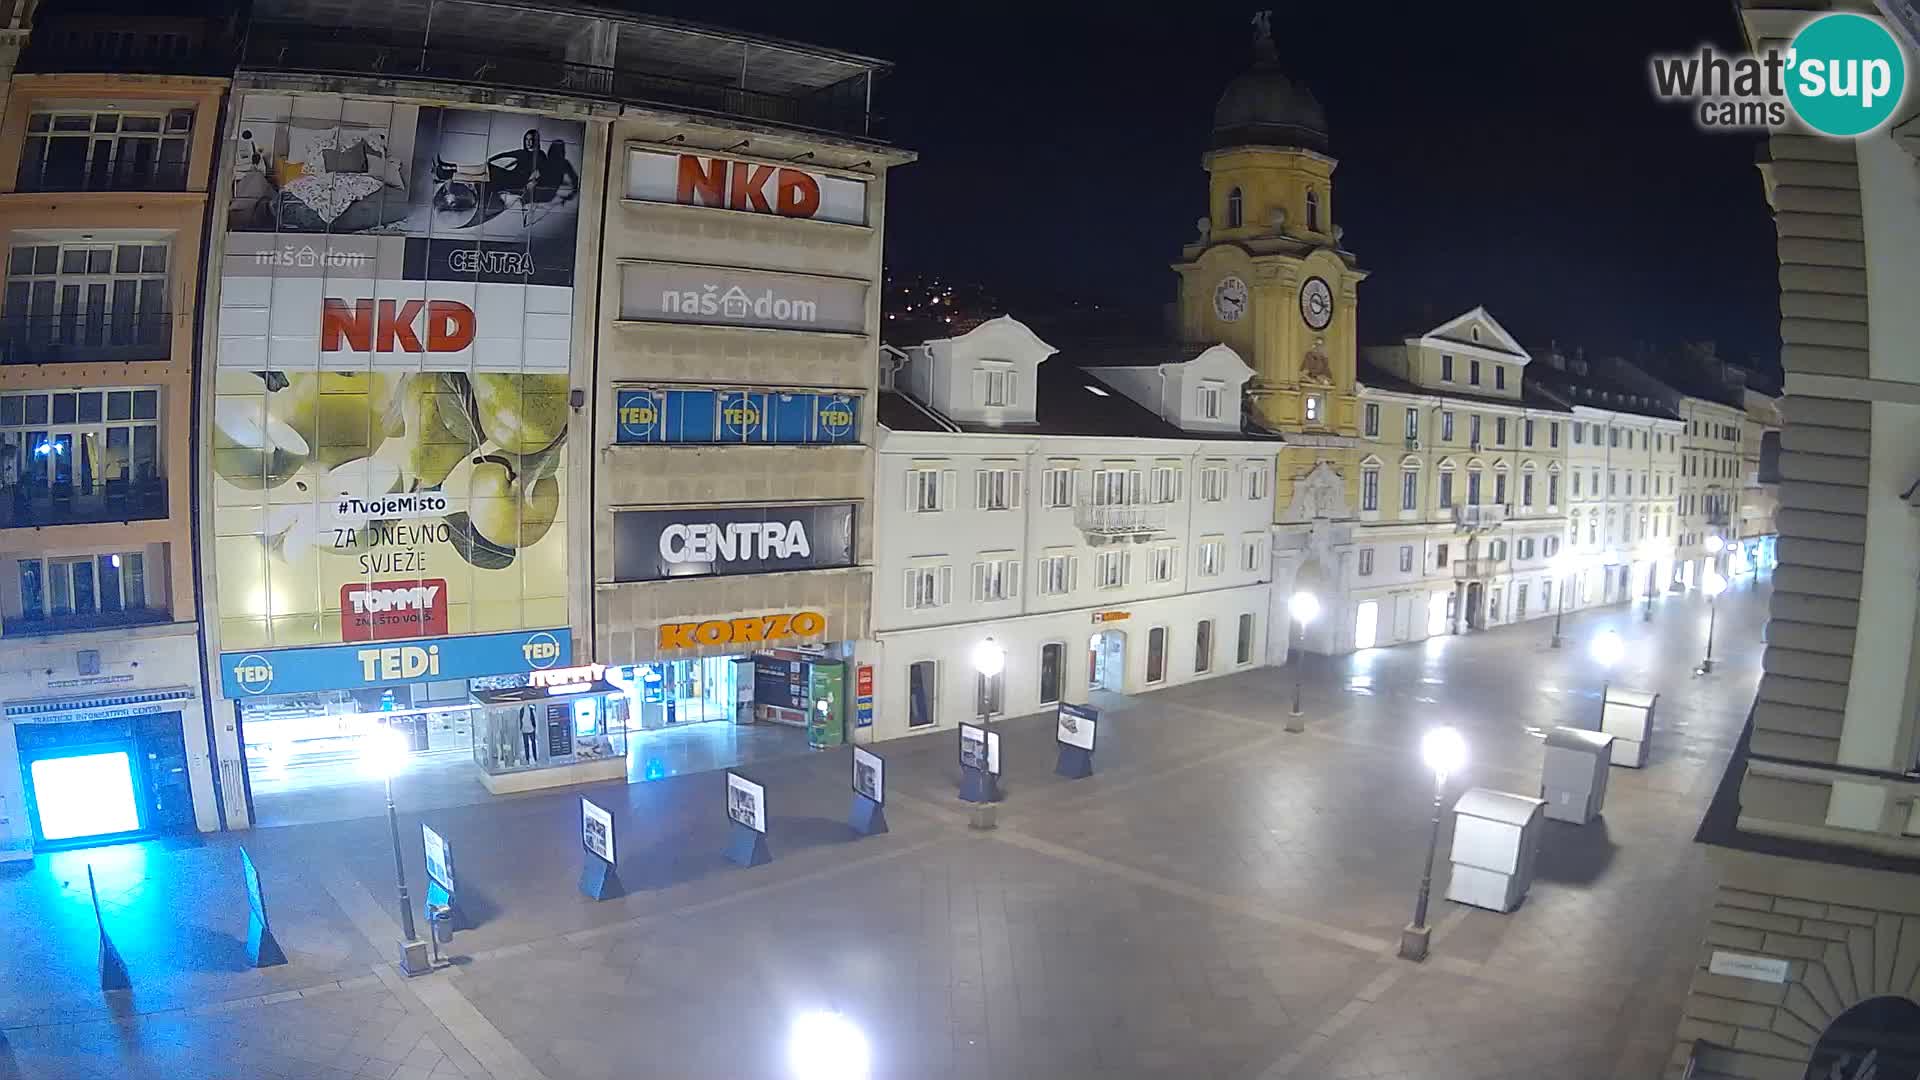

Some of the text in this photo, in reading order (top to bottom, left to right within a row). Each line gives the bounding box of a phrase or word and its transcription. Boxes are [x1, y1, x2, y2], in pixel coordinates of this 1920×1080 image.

[676, 153, 820, 218] NKD
[255, 244, 366, 269] naš dom
[448, 248, 535, 275] CENTRA
[661, 284, 816, 322] naš dom
[321, 297, 477, 353] NKD
[619, 407, 658, 425] TEDi
[724, 408, 760, 425] TEDi
[820, 410, 853, 426] TEDi
[338, 496, 446, 515] #TvojeMisto
[334, 523, 450, 548] ZA DNEVNO
[659, 520, 810, 563] CENTRA
[360, 547, 426, 574] SVJEŽE
[349, 586, 439, 614] TOMMY
[658, 611, 826, 650] KORZO
[358, 644, 439, 682] TEDi
[523, 641, 560, 660] TEDi
[234, 665, 273, 684] TEDi
[529, 662, 606, 687] TOMMY
